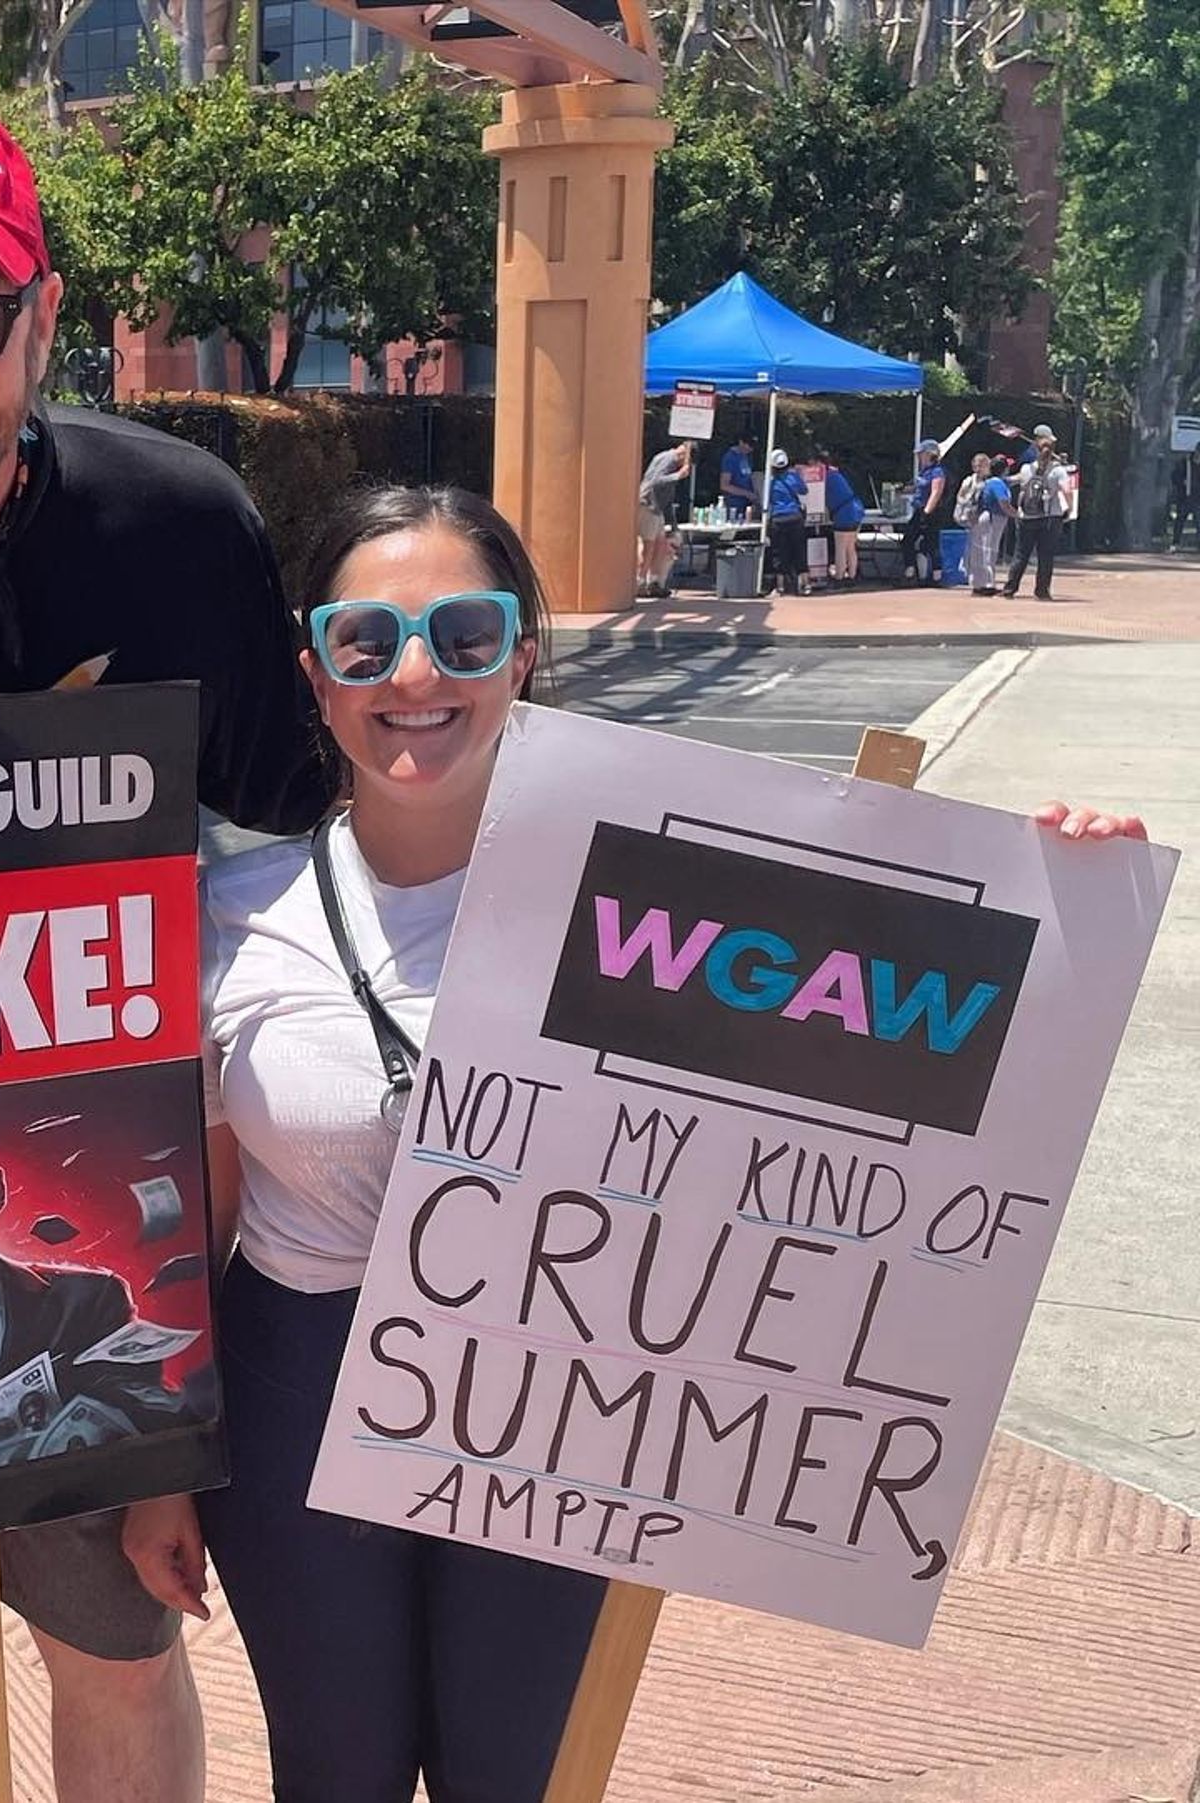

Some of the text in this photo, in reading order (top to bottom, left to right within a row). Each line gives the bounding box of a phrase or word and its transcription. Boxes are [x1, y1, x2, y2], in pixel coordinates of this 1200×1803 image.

[595, 896, 1000, 1052] WGAW
[415, 1057, 1050, 1259] NOT MY KIND OF
[410, 1176, 951, 1408] CRUEL
[358, 1317, 948, 1580] SUMMER,
[406, 1463, 684, 1564] AMPTP
